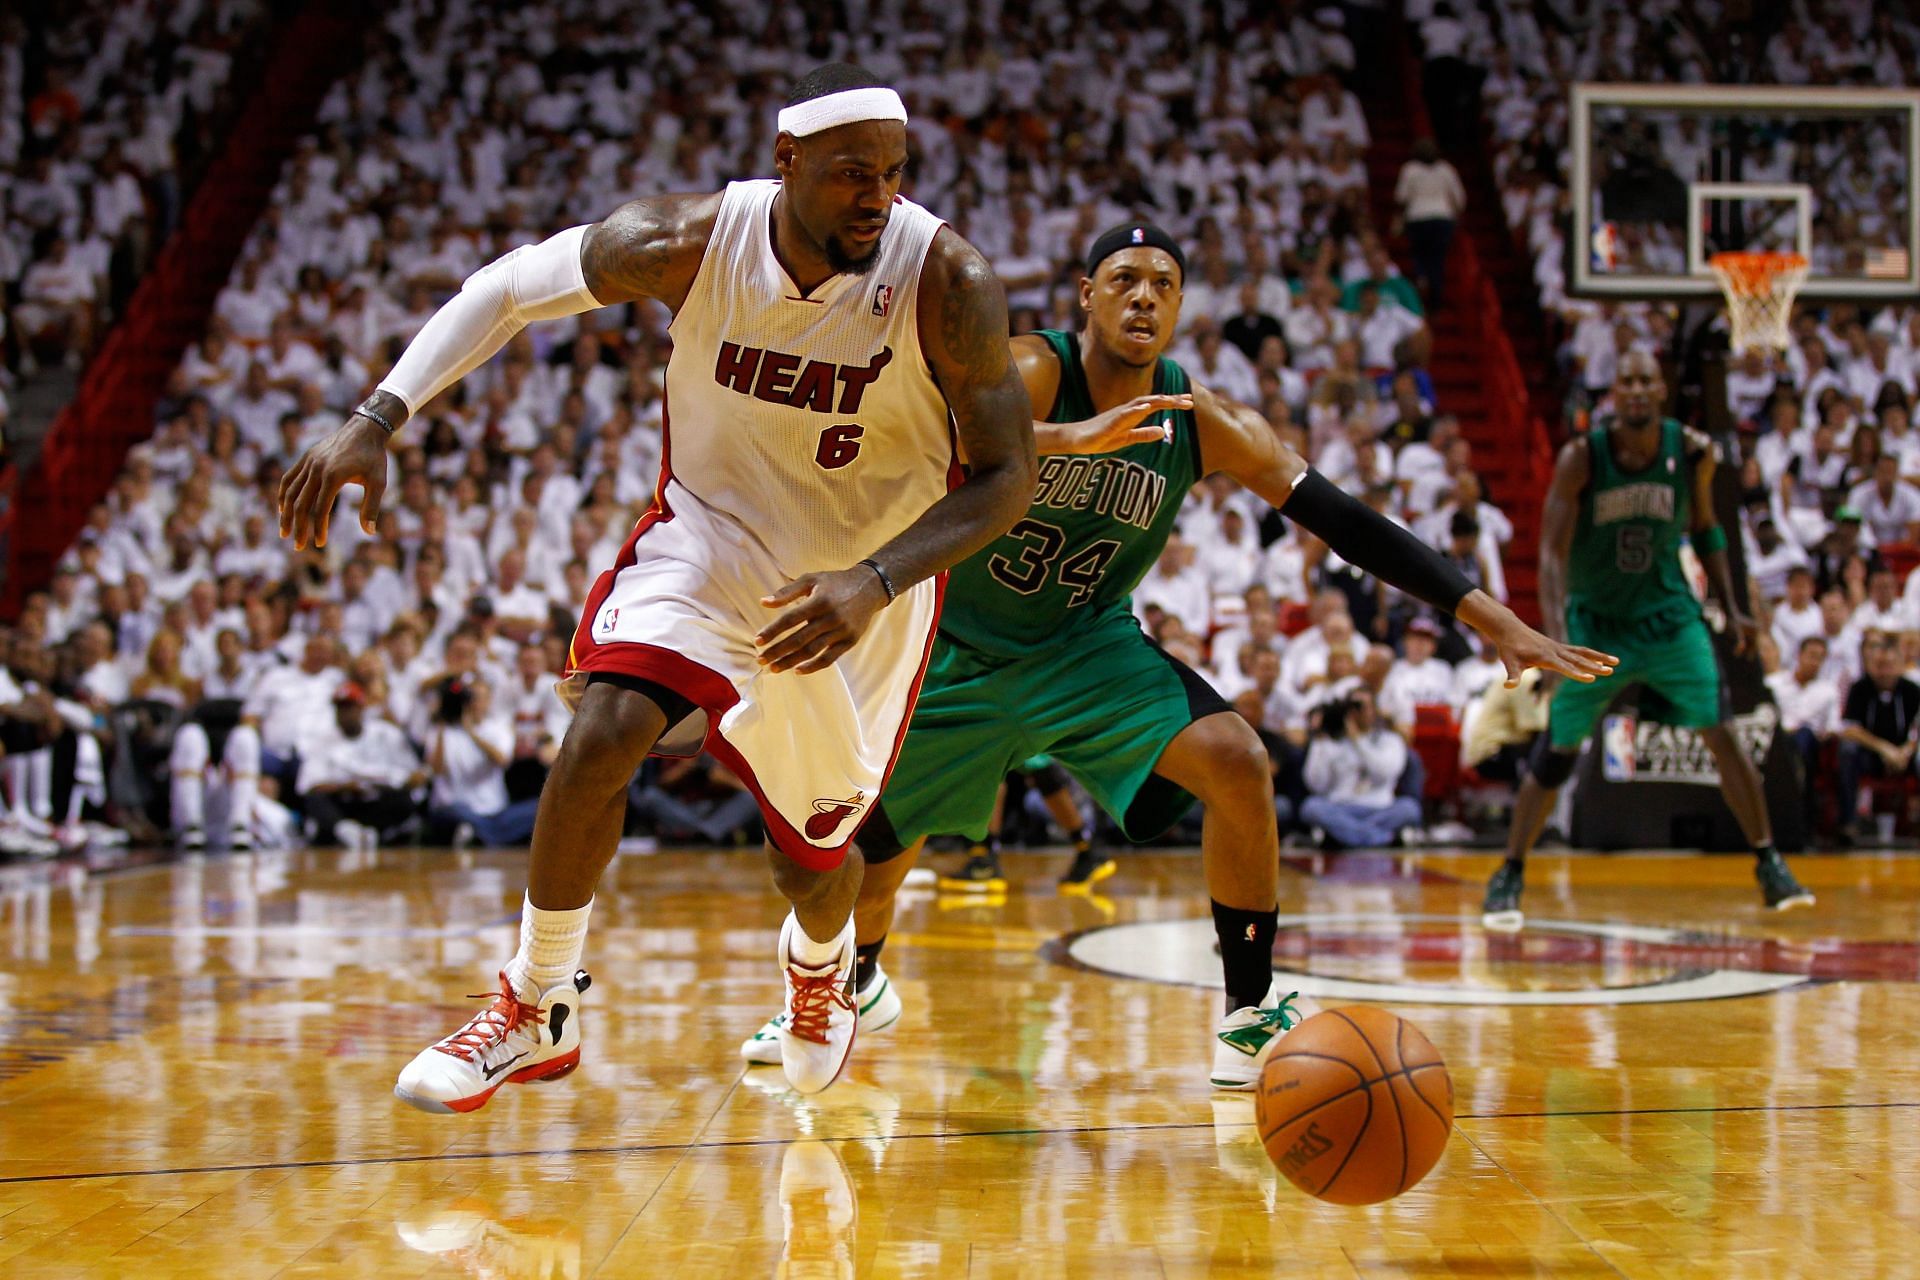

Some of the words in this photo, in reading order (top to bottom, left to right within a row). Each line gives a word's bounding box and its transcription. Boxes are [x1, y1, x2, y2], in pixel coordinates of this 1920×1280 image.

[715, 341, 893, 415] HEAT
[815, 423, 865, 470] 6
[1032, 456, 1166, 530] BOSTON
[987, 517, 1122, 608] 34
[1616, 526, 1653, 573] 5
